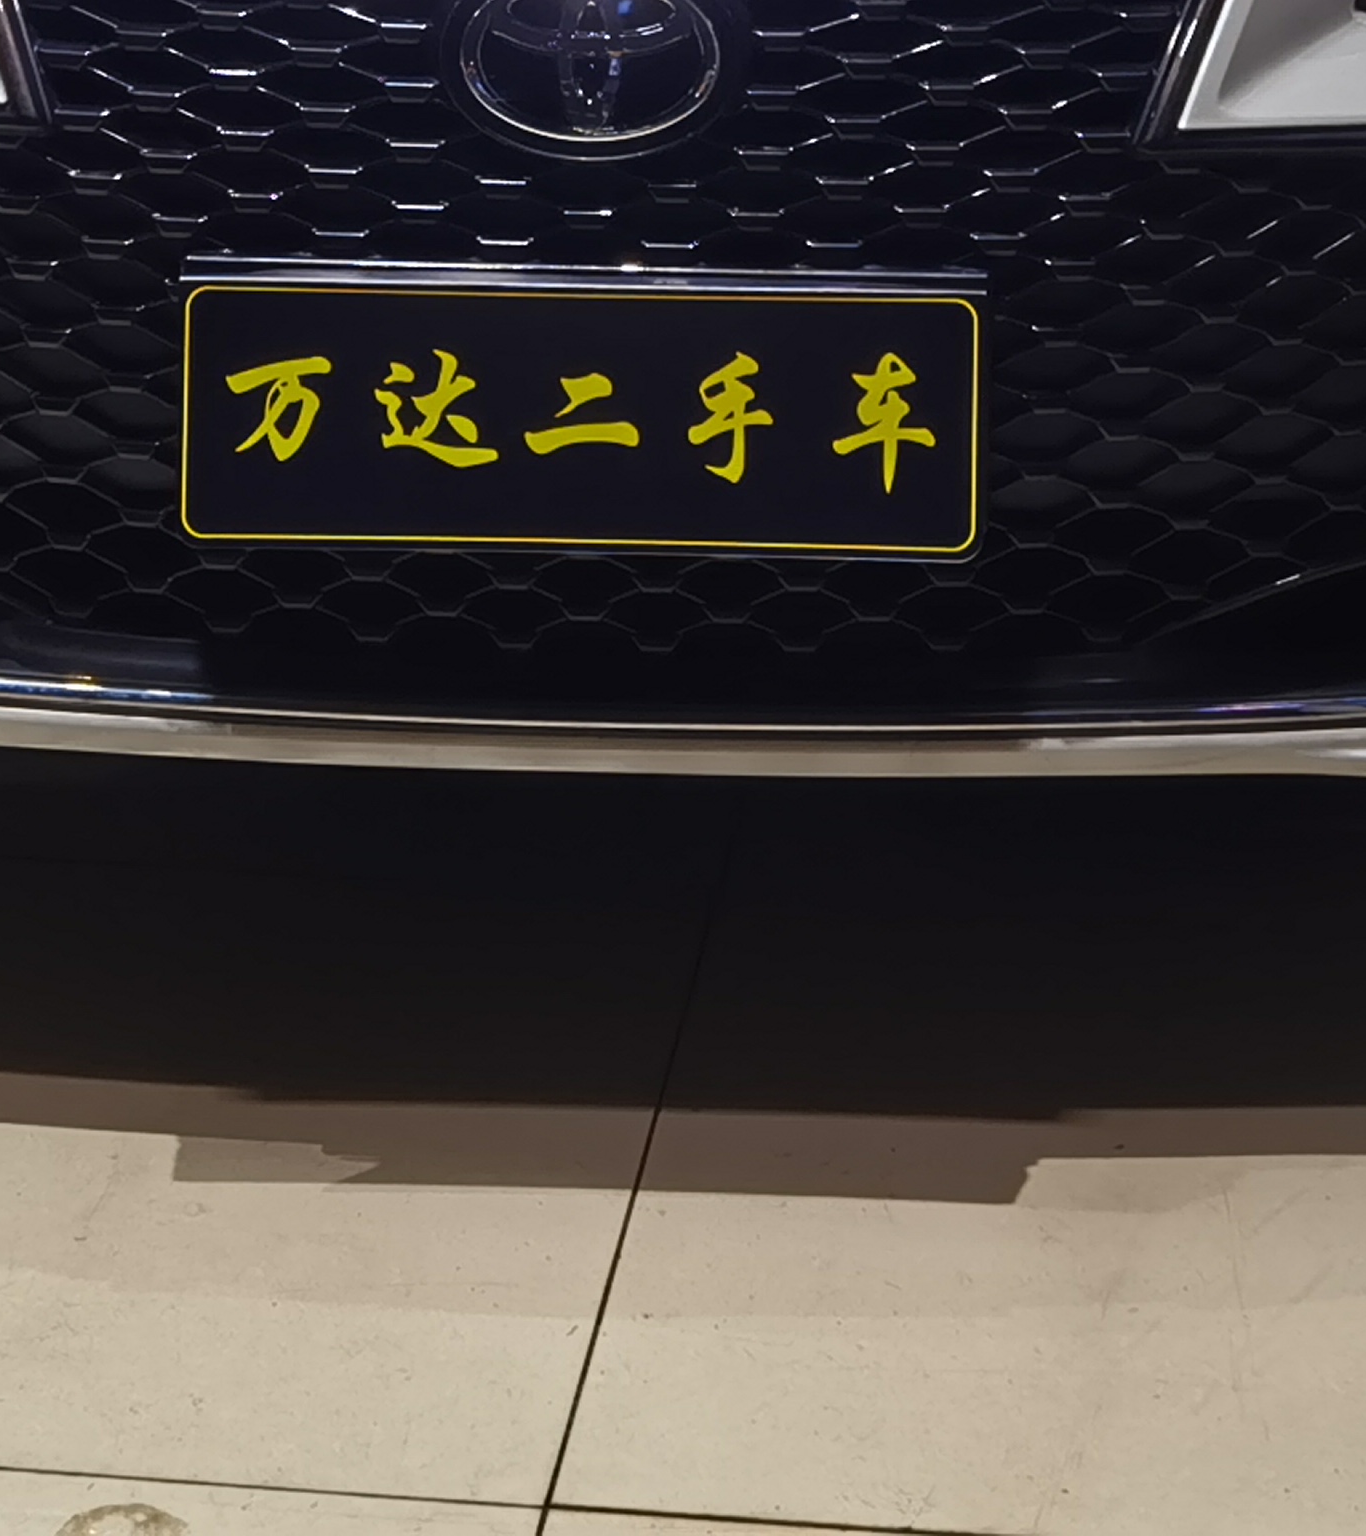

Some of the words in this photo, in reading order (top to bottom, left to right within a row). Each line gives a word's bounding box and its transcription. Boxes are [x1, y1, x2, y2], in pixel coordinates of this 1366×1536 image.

[225, 349, 936, 494] 万达二手车
